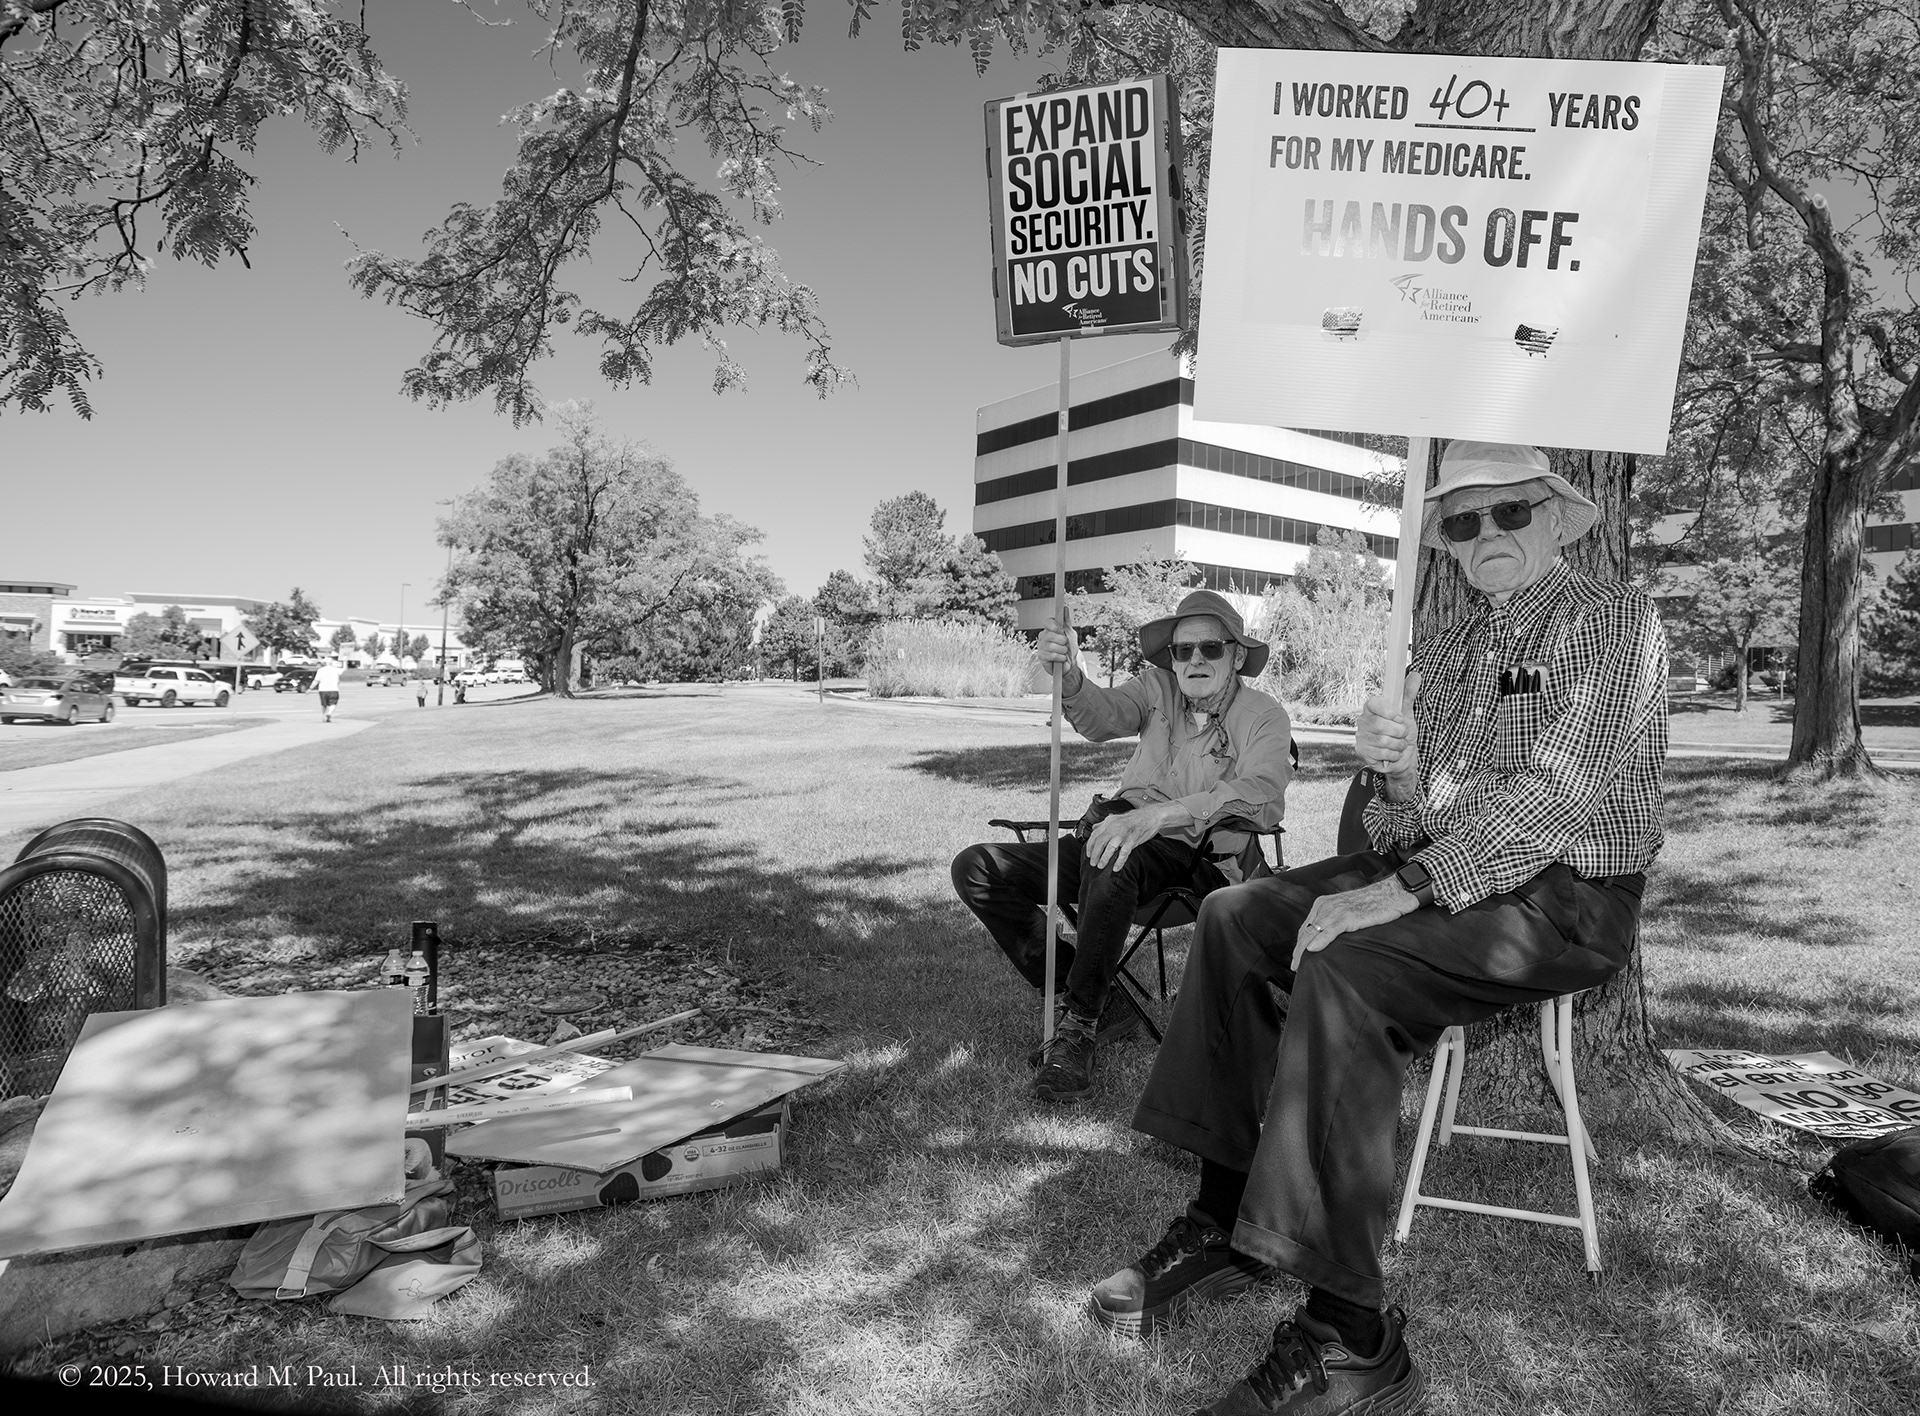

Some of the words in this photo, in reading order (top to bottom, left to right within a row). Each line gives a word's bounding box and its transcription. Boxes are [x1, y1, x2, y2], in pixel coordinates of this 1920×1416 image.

[1273, 82, 1282, 115] I
[1292, 82, 1409, 120] WORKED
[1429, 74, 1510, 122] 40+
[1548, 92, 1641, 131] YEARS
[1006, 86, 1149, 157] EXPAND
[1008, 140, 1152, 213] SOCIAL
[1269, 135, 1322, 170] FOR
[1330, 138, 1375, 172] MY
[1382, 140, 1532, 180] MEDICARE.
[1009, 199, 1154, 256] SECURITY.
[1300, 198, 1468, 265] HANDS
[1483, 207, 1581, 272] OFF.
[1013, 260, 1058, 306] NO
[1066, 248, 1155, 300] CUTS
[1422, 288, 1469, 301] Alliance
[1430, 299, 1472, 312] Retired
[1759, 1090, 1850, 1110] NO
[503, 1206, 534, 1217] Organic
